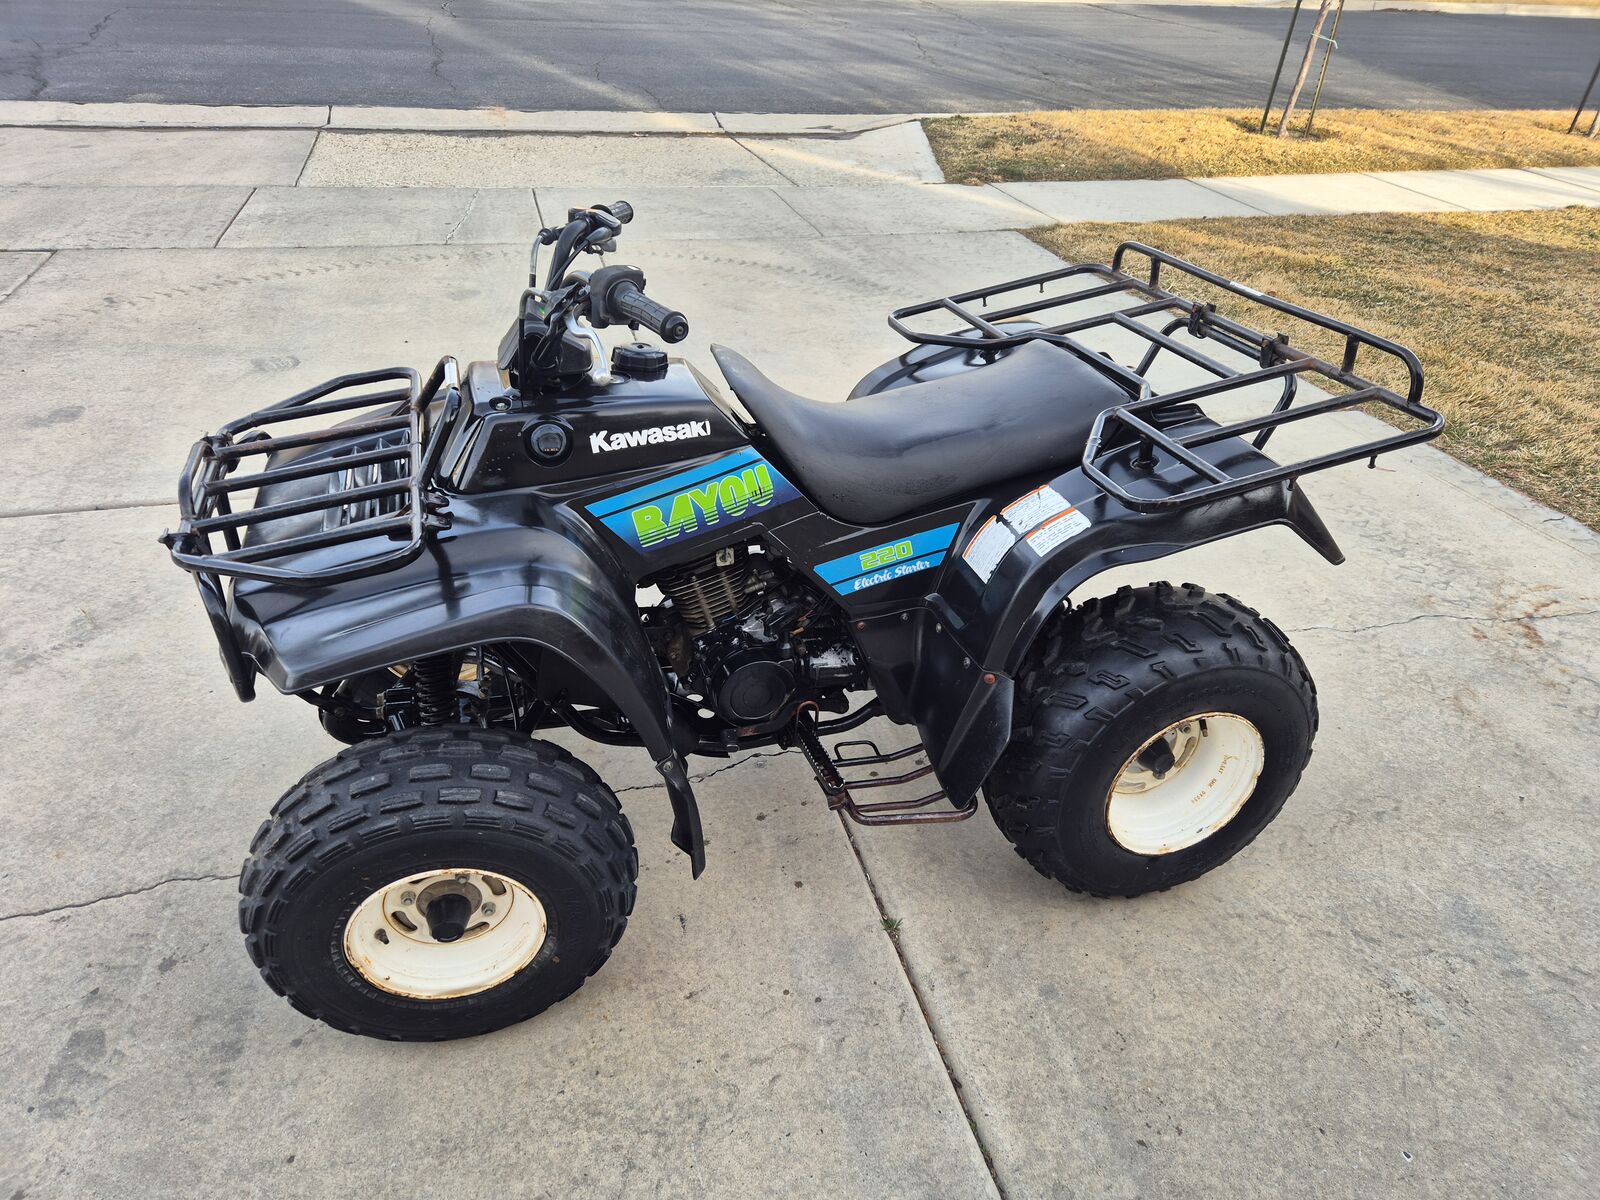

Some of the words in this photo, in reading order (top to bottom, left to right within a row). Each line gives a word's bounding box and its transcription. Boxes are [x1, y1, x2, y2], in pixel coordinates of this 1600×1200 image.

[589, 420, 711, 454] Kawasaki
[631, 464, 774, 547] BAYOU
[859, 540, 913, 571] 220
[854, 571, 892, 591] Electric
[894, 560, 931, 579] Starter
